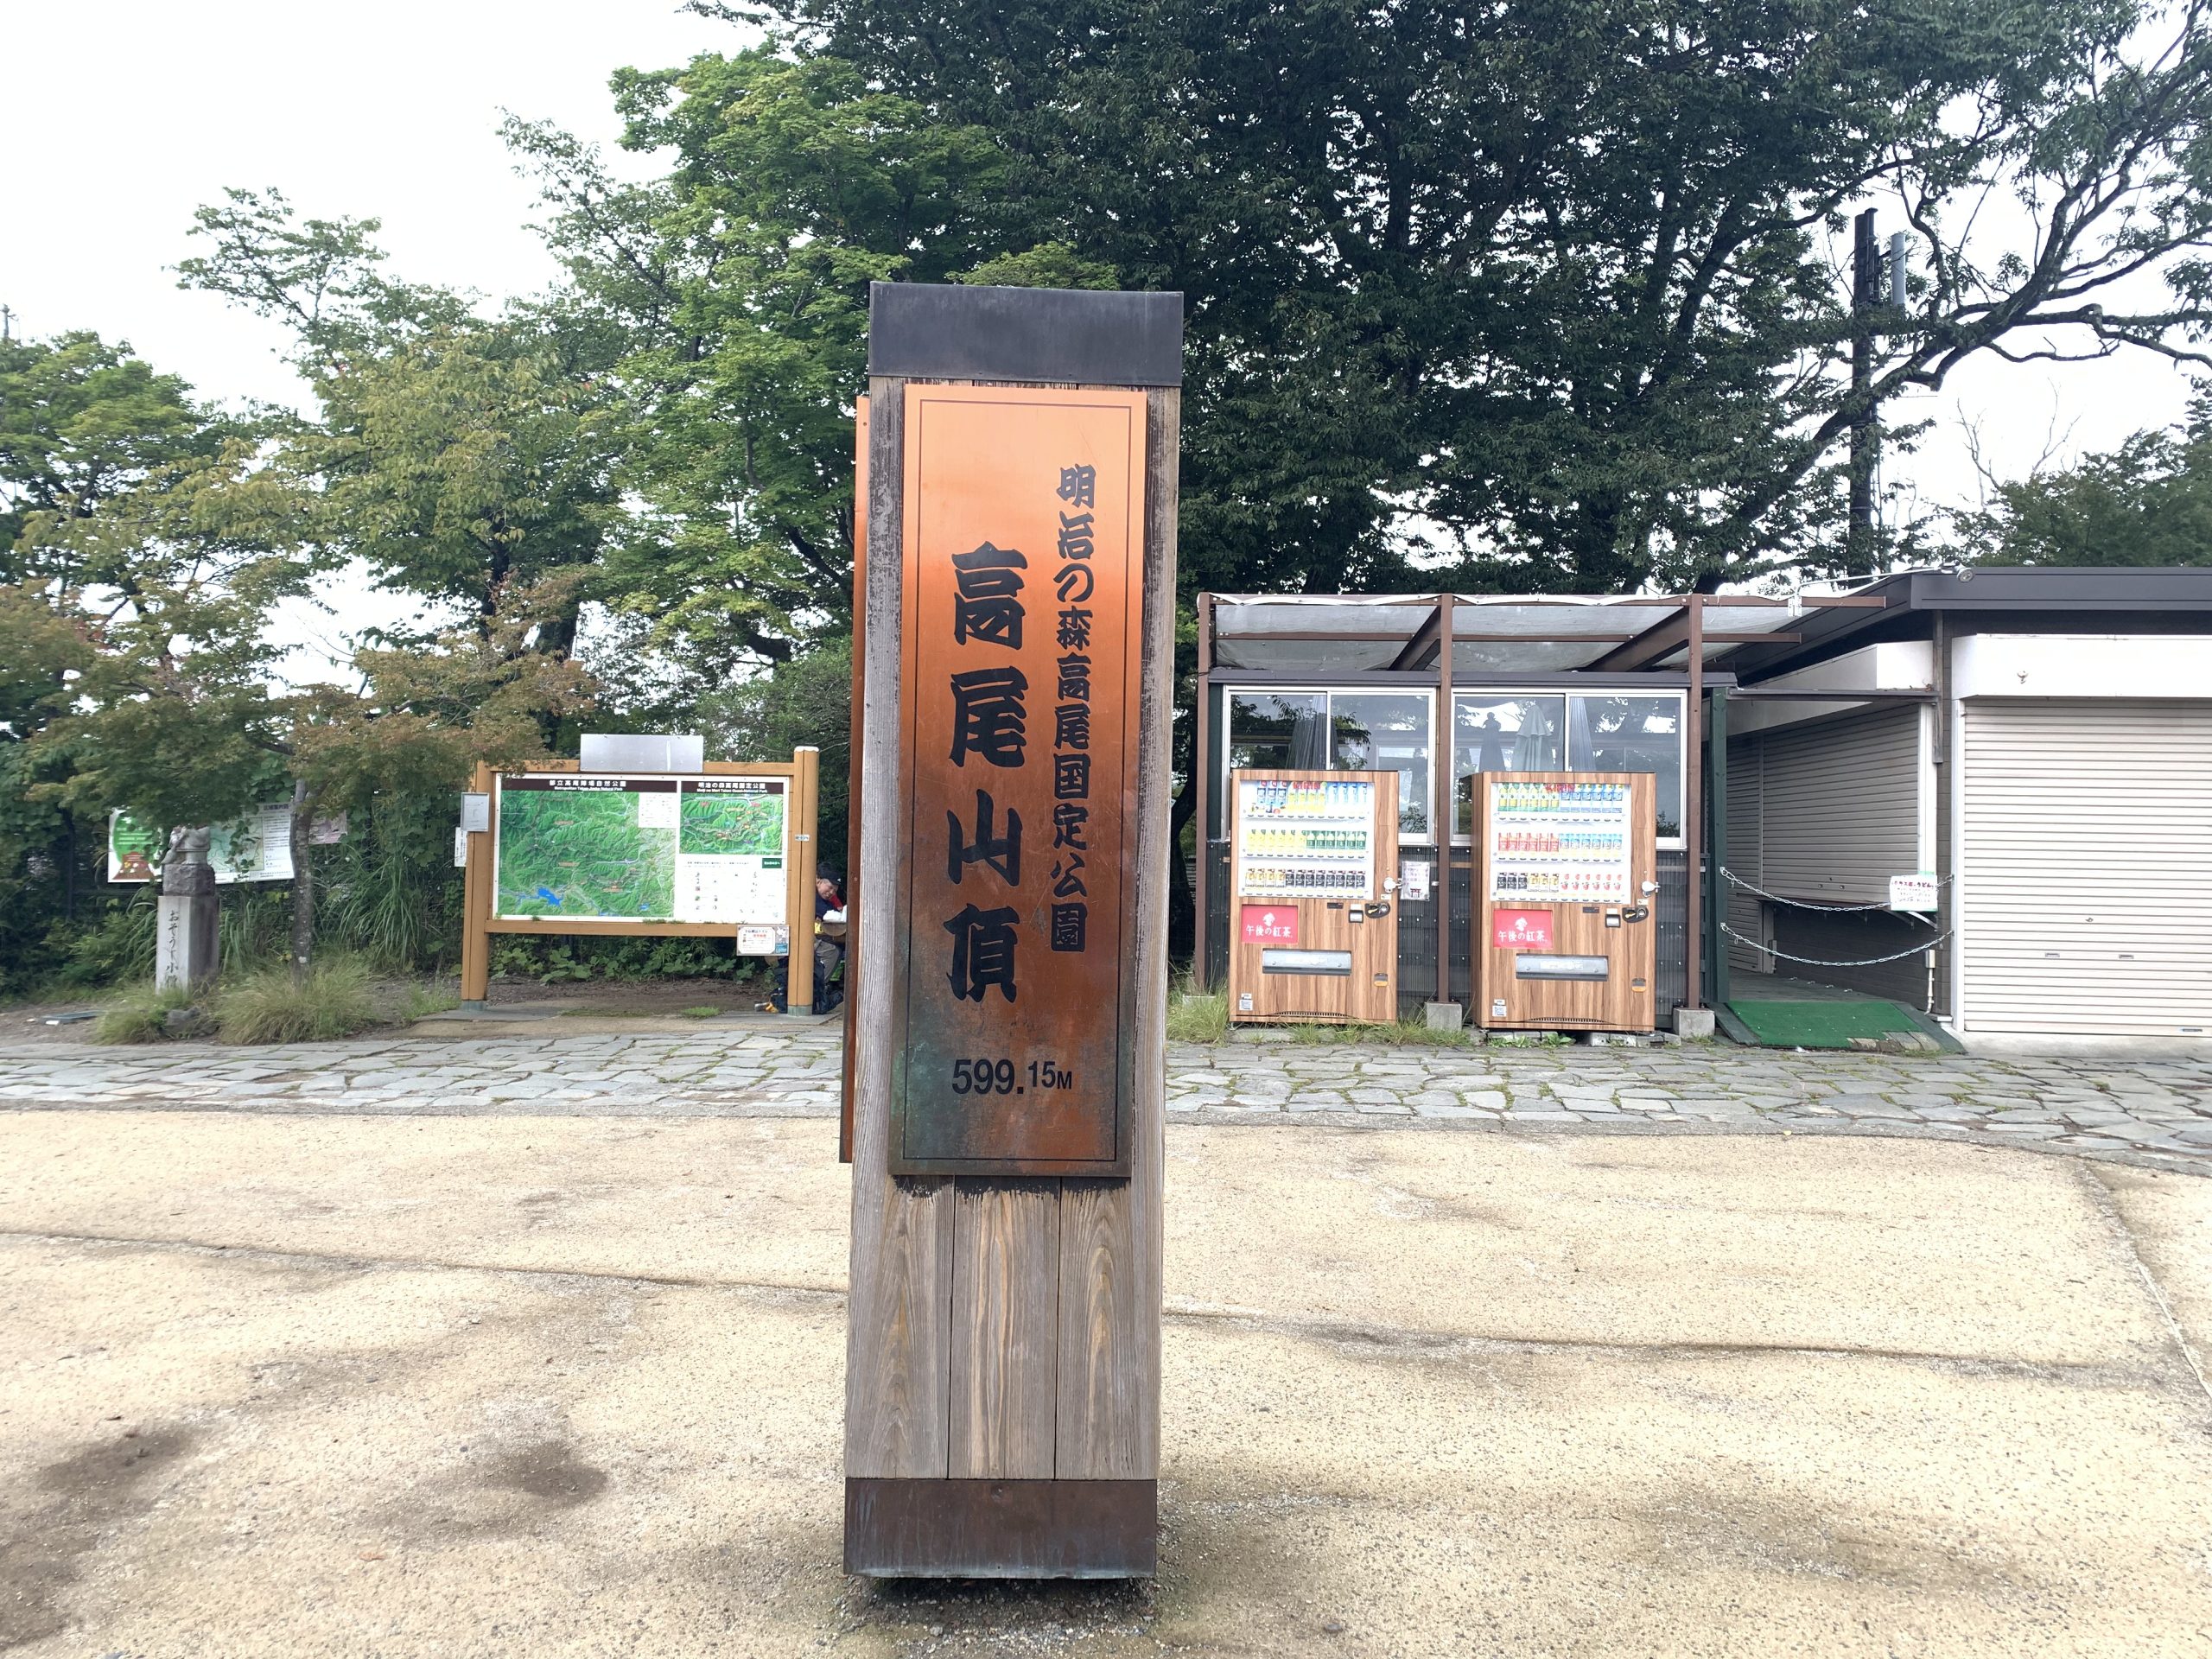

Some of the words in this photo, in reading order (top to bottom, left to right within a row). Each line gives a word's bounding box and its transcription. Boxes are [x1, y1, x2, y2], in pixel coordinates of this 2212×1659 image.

[943, 541, 1029, 1003] 高尾山頂
[1051, 463, 1096, 952] 明治の森高尾国定公園
[1246, 925, 1291, 938] 午後の紅茶
[1498, 931, 1545, 942] 午後の紅茶
